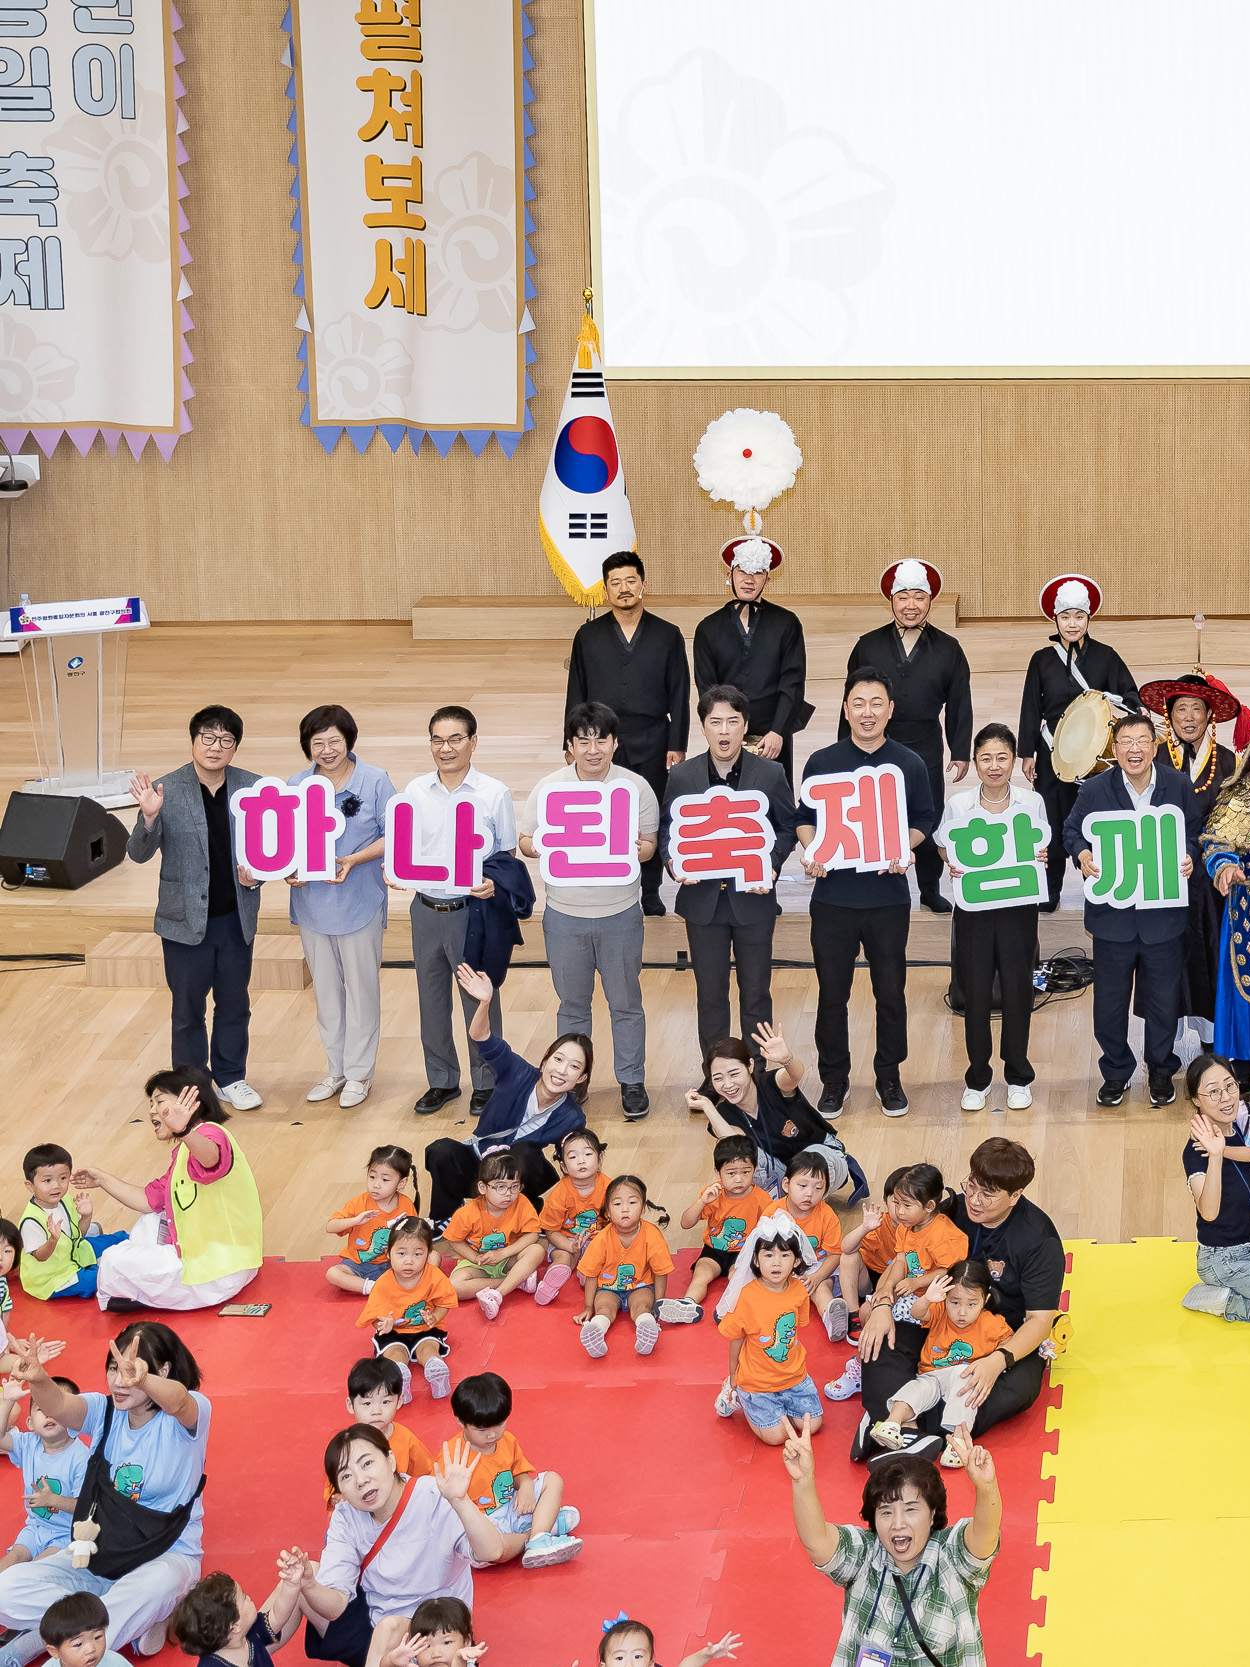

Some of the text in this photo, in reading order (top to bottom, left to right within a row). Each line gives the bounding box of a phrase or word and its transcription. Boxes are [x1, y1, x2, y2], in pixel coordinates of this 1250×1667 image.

[0, 150, 65, 310] 축제
[354, 0, 428, 317] 펼쳐보세
[676, 771, 905, 884] 축제
[948, 811, 1181, 904] 함께
